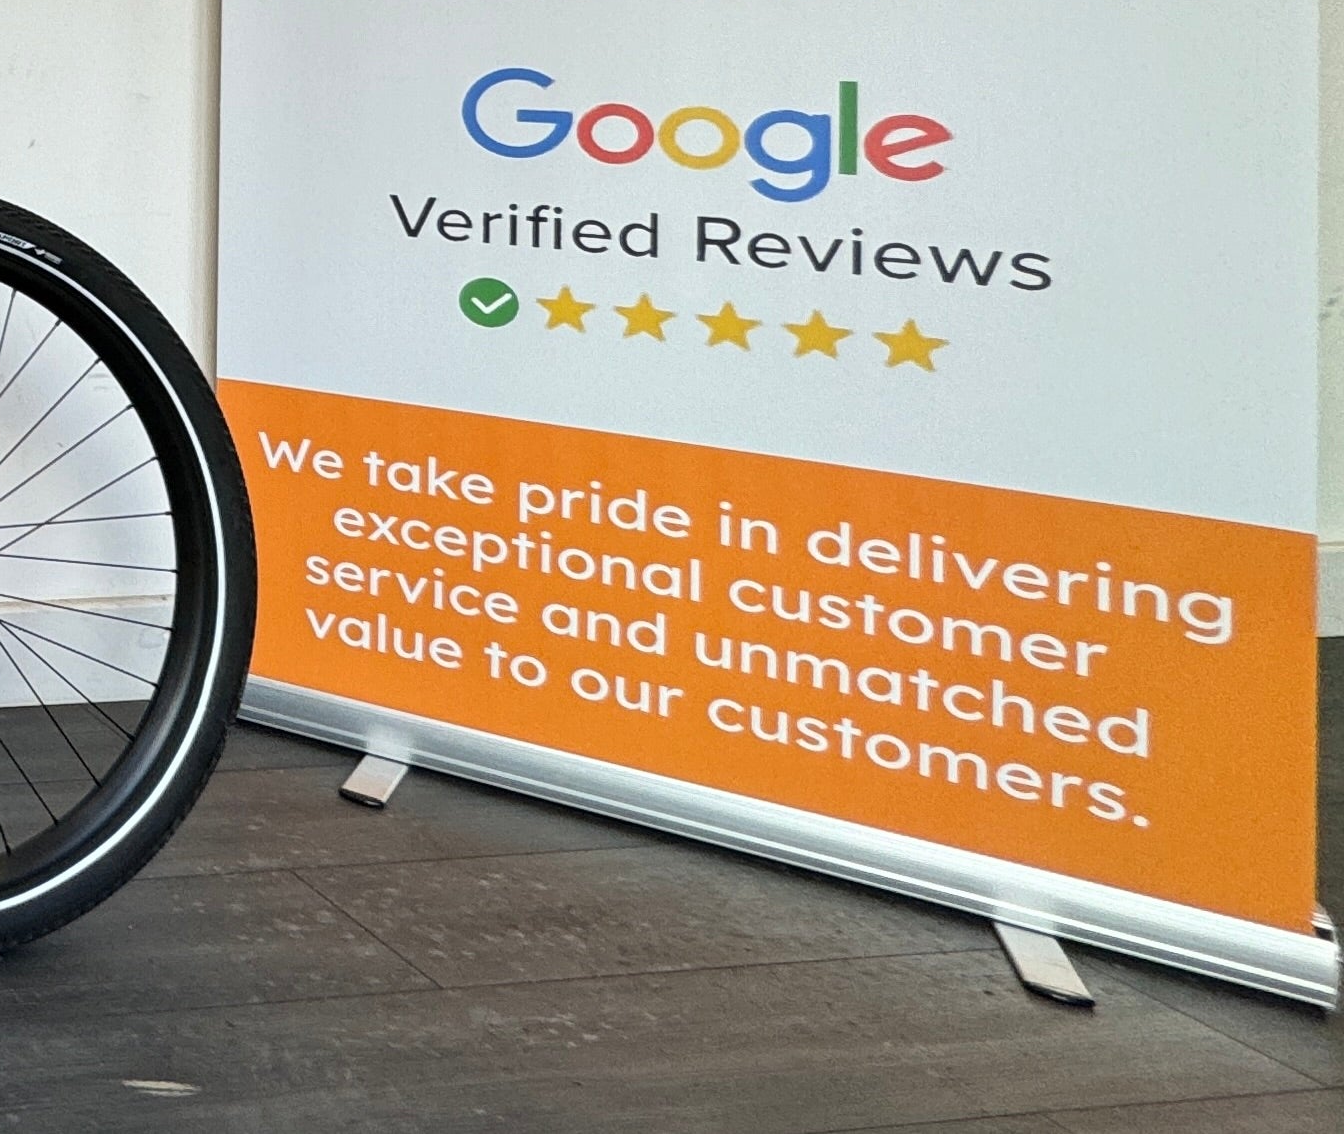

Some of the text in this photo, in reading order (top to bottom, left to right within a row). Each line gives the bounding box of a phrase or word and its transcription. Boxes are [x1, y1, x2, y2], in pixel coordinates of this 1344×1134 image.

[461, 67, 952, 204] Google
[389, 194, 1053, 292] Verified Reviews
[257, 431, 1235, 646] We take pride in delivering
[332, 505, 1110, 678] exceptional customer
[304, 554, 1152, 759] service and unmatched
[304, 608, 1152, 830] value to our customers.
